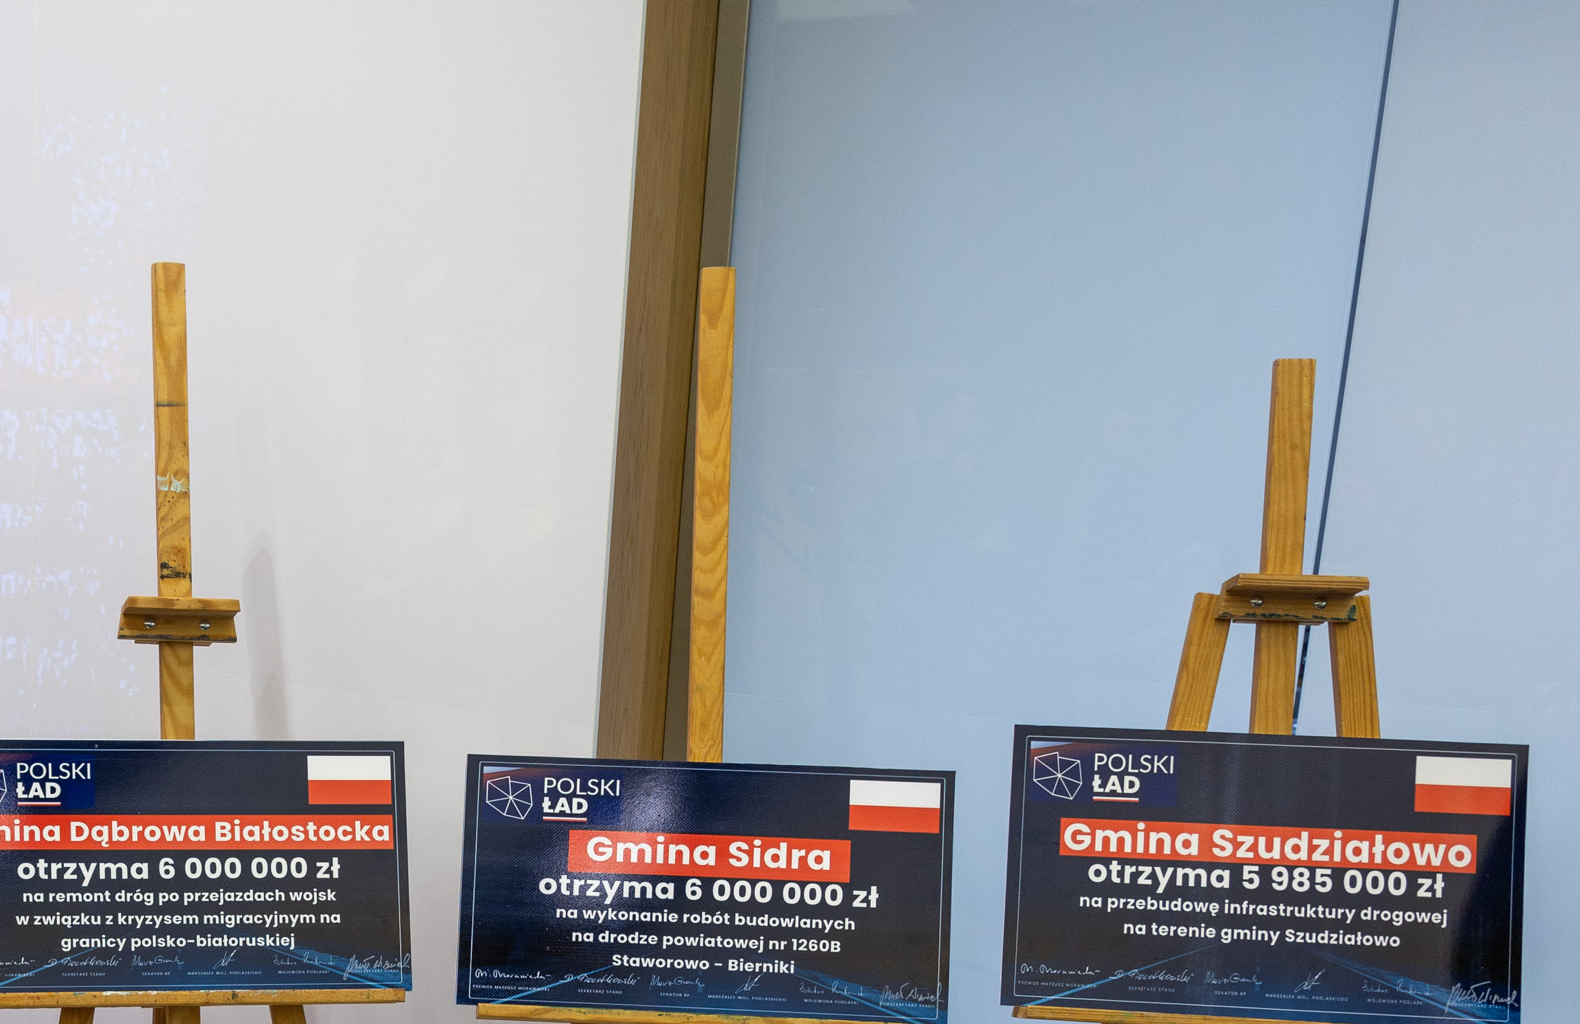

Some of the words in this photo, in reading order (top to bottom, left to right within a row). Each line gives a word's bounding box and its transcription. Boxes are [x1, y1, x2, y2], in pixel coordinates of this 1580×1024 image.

[15, 761, 92, 781] POLSKI
[1093, 751, 1175, 775] POLSKI
[14, 780, 62, 800] ŁAD
[542, 776, 622, 798] POLSKI
[1091, 773, 1142, 795] ŁAD
[540, 795, 590, 815] ŁAD
[69, 819, 207, 849] Dąbrowa
[213, 818, 391, 843] Białostocka
[1062, 821, 1201, 857] Gmina
[1210, 827, 1473, 869] Szudziałowo
[585, 834, 718, 867] Gmina
[727, 837, 832, 872] Sidra
[16, 857, 150, 888] otrzyma
[157, 856, 177, 881] 6
[183, 856, 243, 880] 000
[249, 855, 309, 880] 000
[314, 855, 342, 880] zł
[1086, 859, 1231, 895] otrzyma
[1241, 863, 1261, 891] 5
[1270, 865, 1334, 894] 985
[1342, 868, 1408, 897] 000
[1415, 872, 1446, 899] zł
[21, 891, 45, 904] na
[47, 889, 112, 904] remont
[113, 887, 155, 907] dróg
[157, 891, 181, 907] po
[182, 887, 287, 907] przejazdach
[287, 886, 338, 906] wojsk
[537, 873, 676, 906] otrzyma
[684, 877, 704, 902] 6
[711, 878, 774, 905] 000
[781, 881, 845, 908] 000
[851, 884, 880, 909] zł
[14, 914, 31, 927] w
[32, 910, 102, 930] związku
[104, 914, 115, 926] z
[116, 911, 200, 930] kryzysem
[202, 909, 317, 929] migracyjnym
[319, 912, 342, 925] na
[555, 907, 579, 920] na
[581, 906, 680, 925] wykonanie
[681, 910, 732, 926] robót
[733, 911, 856, 935] budowlanych
[1078, 895, 1103, 909] na
[1106, 895, 1221, 918] przebudowę
[1223, 898, 1357, 925] infrastruktury
[1359, 905, 1449, 930] drogowej
[59, 933, 128, 953] granicy
[130, 932, 296, 953] polsko-białoruskiej
[570, 931, 595, 944] na
[597, 929, 659, 946] drodze
[661, 932, 765, 954] powiatowej
[767, 939, 789, 952] nr
[790, 937, 842, 954] 1260B
[1122, 922, 1147, 936] na
[1149, 921, 1217, 940] terenie
[1219, 924, 1282, 947] gminy
[1284, 927, 1402, 948] Szudziałowo
[611, 953, 711, 971] Staworowo
[726, 957, 796, 975] Bierniki
